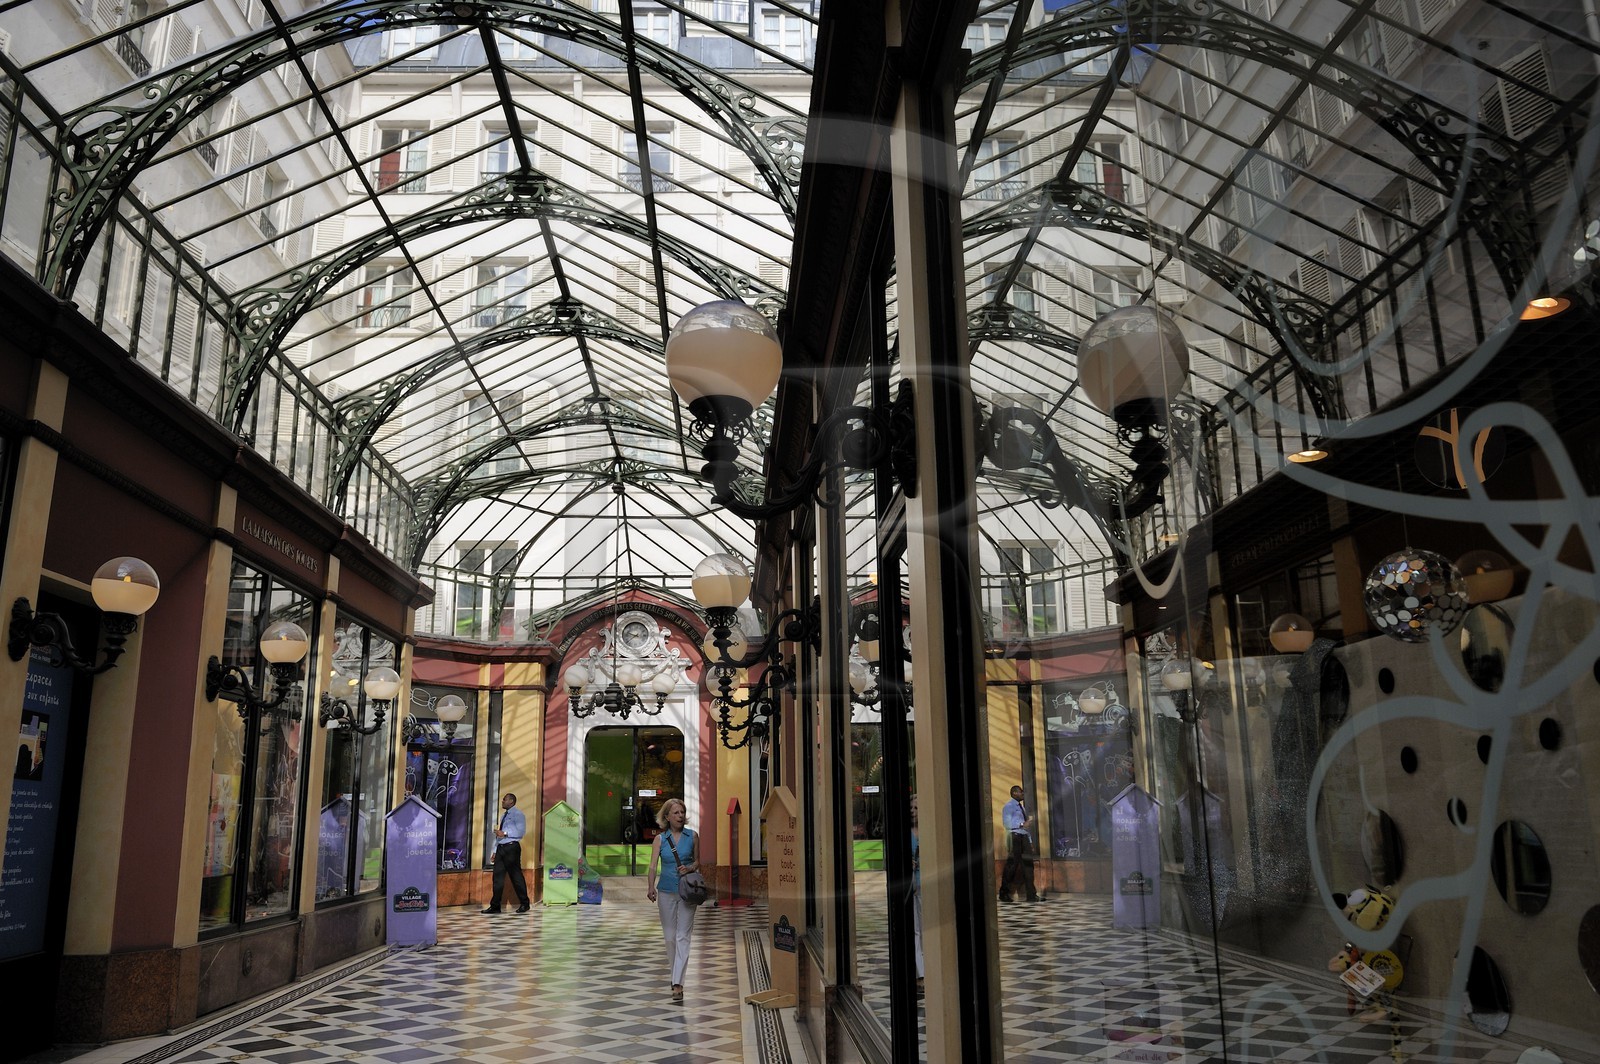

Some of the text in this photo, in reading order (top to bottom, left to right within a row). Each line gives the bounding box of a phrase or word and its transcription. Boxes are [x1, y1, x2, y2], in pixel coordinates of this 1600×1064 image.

[242, 516, 253, 535] LA
[254, 522, 280, 551] MAISON
[281, 540, 295, 560] DES
[663, 609, 677, 620] SUR
[674, 615, 684, 625] LA
[680, 620, 691, 632] VIE
[424, 818, 433, 828] la
[417, 837, 433, 846] des
[405, 847, 433, 858] jouets
[784, 843, 793, 856] des
